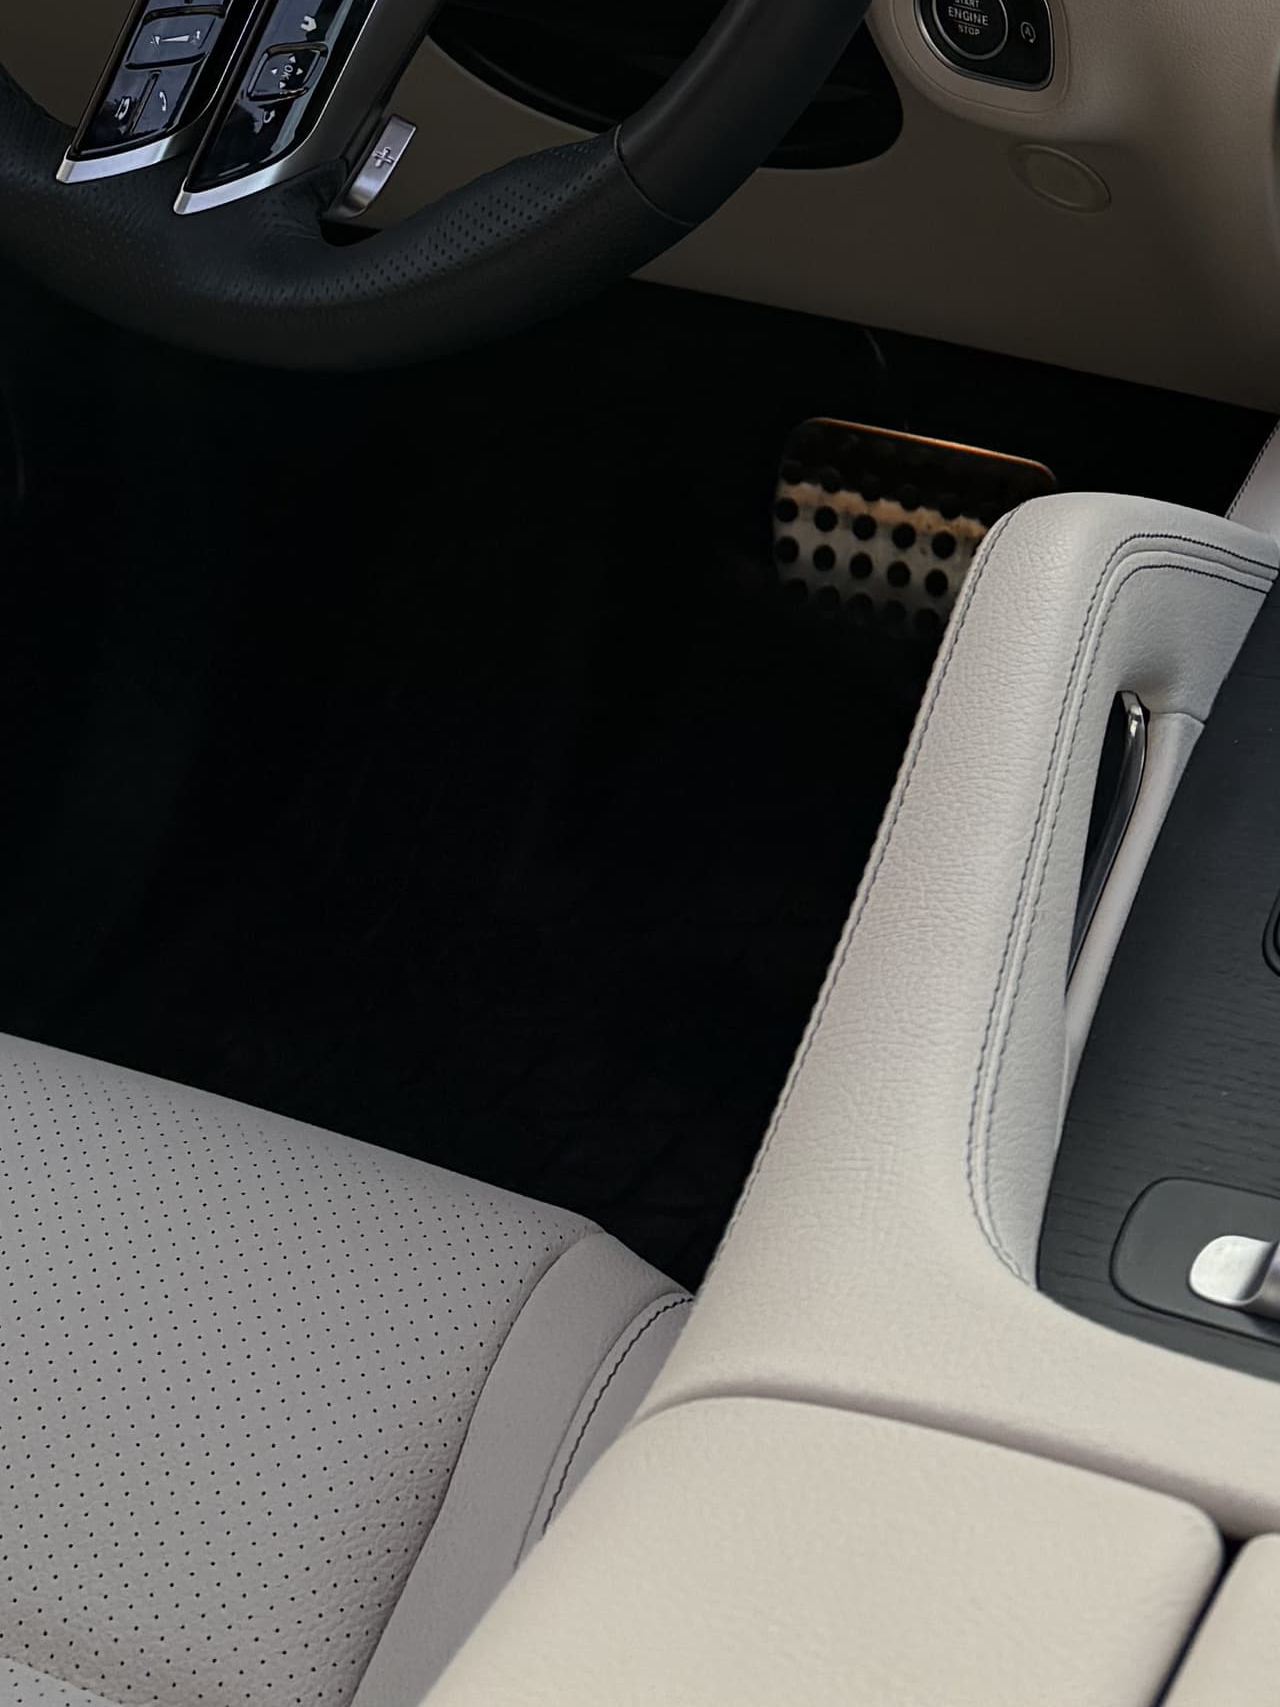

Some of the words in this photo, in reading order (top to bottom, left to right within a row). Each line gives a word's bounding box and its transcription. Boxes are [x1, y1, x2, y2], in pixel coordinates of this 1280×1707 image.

[948, 6, 989, 26] ENGINE
[958, 24, 980, 36] STOP
[282, 64, 294, 80] OK
